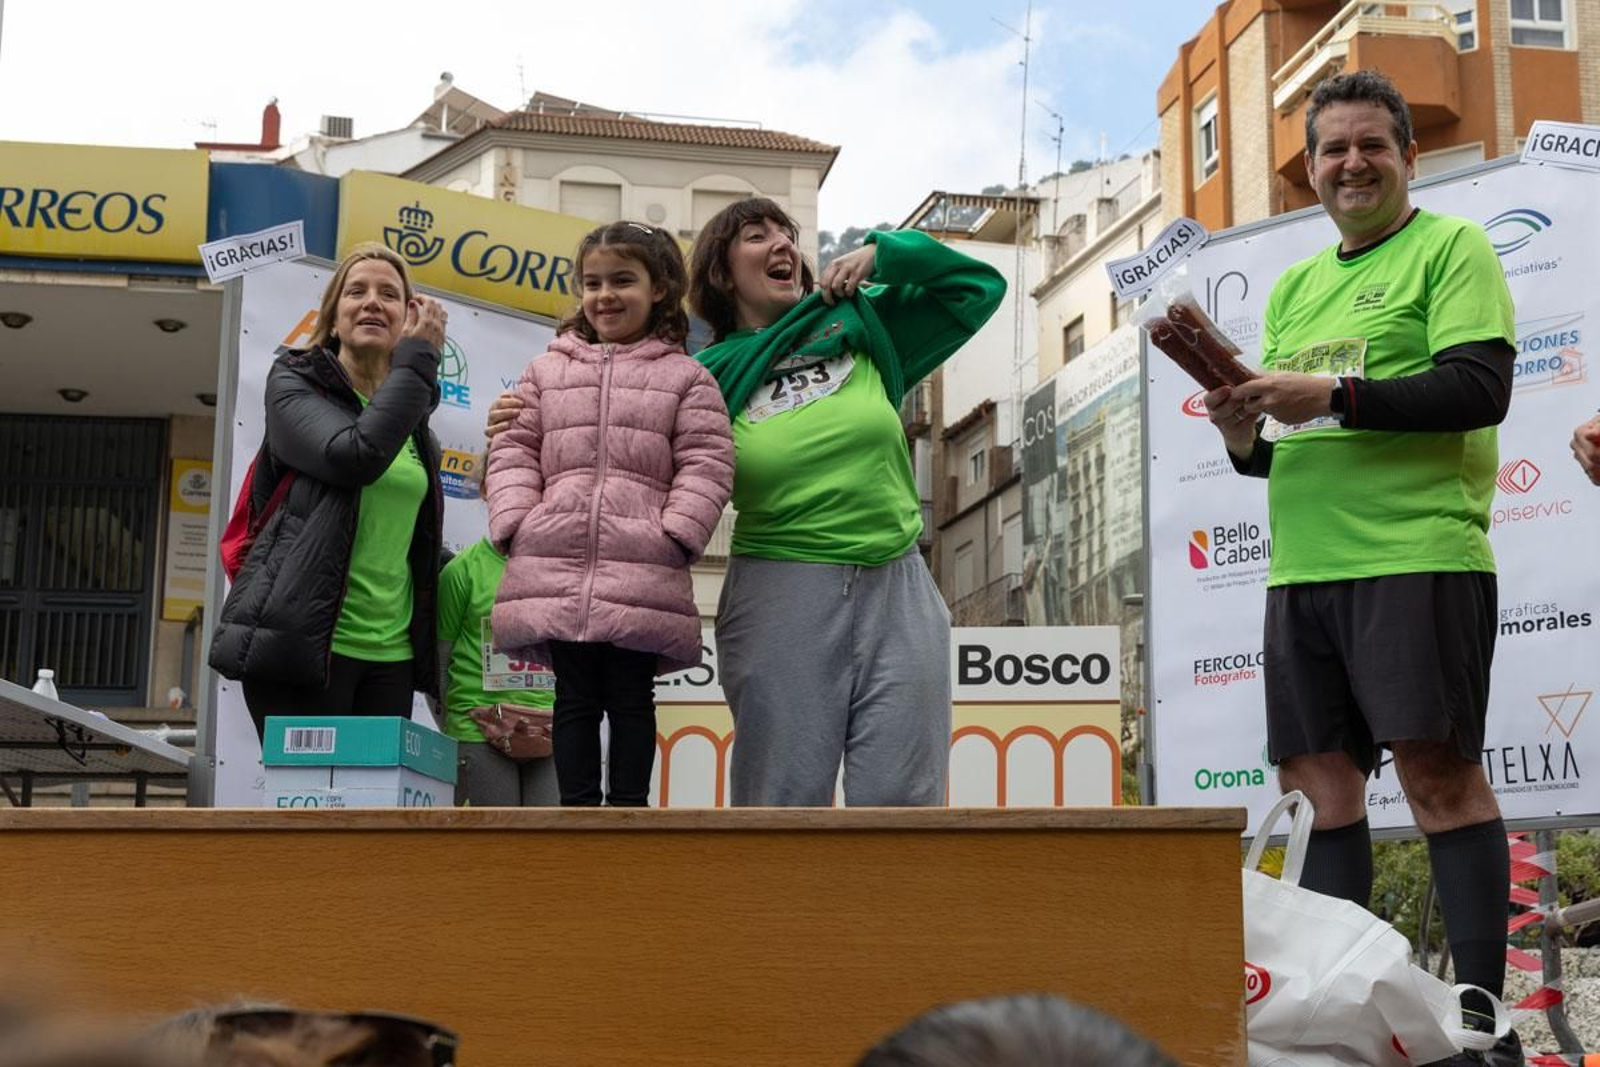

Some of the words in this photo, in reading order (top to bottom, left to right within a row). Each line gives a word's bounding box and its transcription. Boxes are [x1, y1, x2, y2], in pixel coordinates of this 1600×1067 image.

[208, 233, 294, 273] ¡GRACIAS!
[1115, 223, 1196, 290] ¡GRACIAS!
[765, 361, 830, 401] 253
[1213, 522, 1260, 546] Bello
[1213, 539, 1271, 567] Cabell
[1500, 611, 1592, 636] morales
[958, 644, 1111, 686] Bosco
[1195, 768, 1266, 790] Orona
